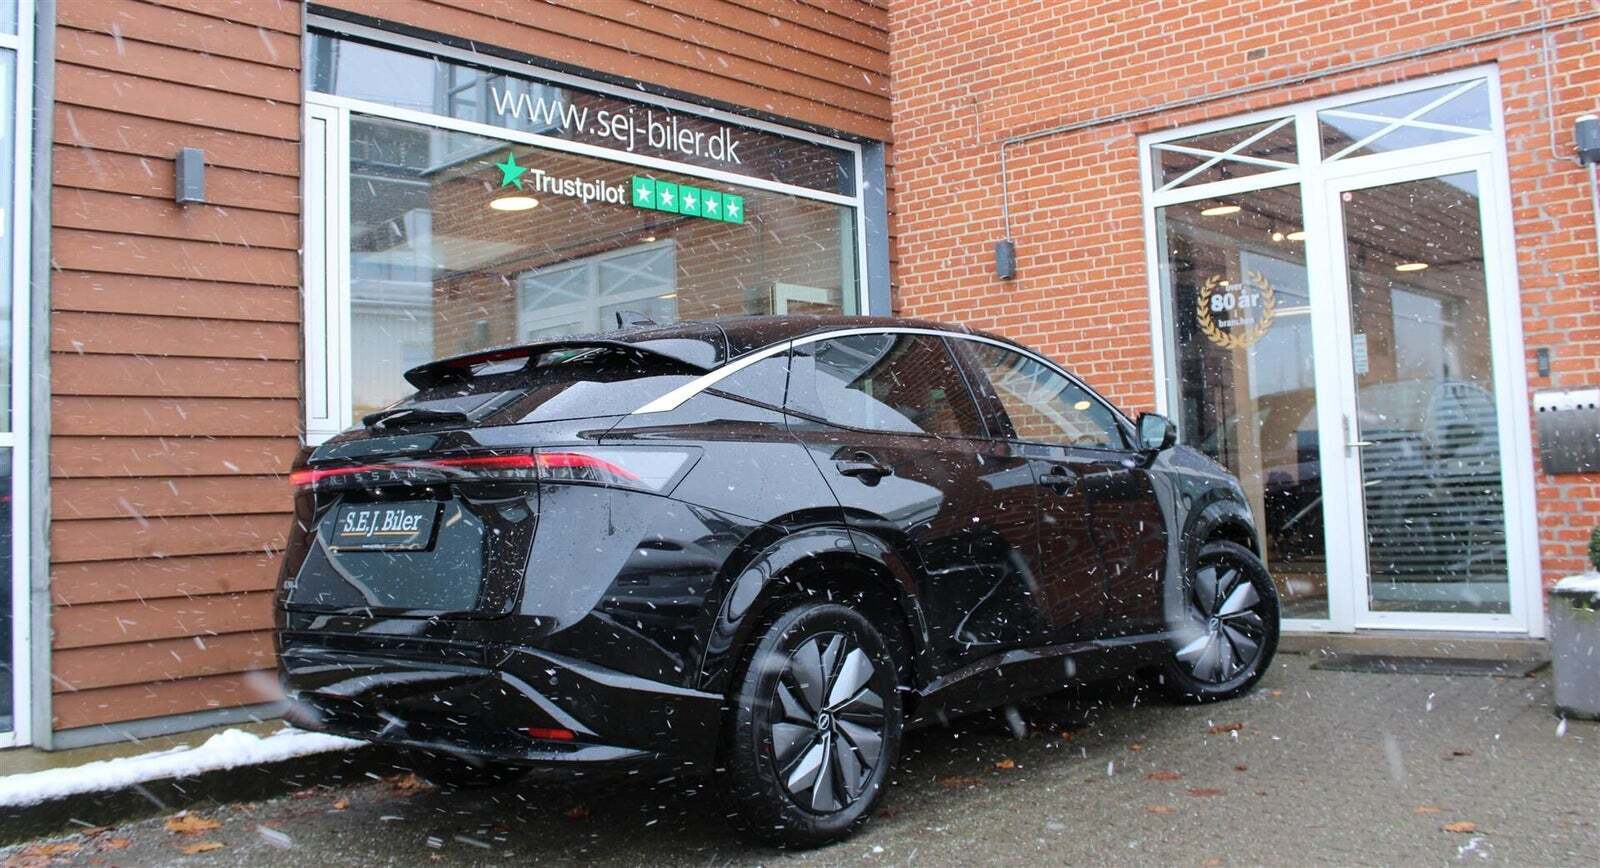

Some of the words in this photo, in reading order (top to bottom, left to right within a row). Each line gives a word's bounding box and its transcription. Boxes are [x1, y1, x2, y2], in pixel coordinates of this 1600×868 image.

[491, 86, 742, 164] www.sej-biler.dk
[530, 168, 626, 205] Trustpilot
[1211, 292, 1236, 312] 80
[1238, 288, 1260, 308] år
[330, 468, 417, 487] NISSAN
[343, 511, 379, 537] S.E.J.
[381, 509, 423, 531] Biler
